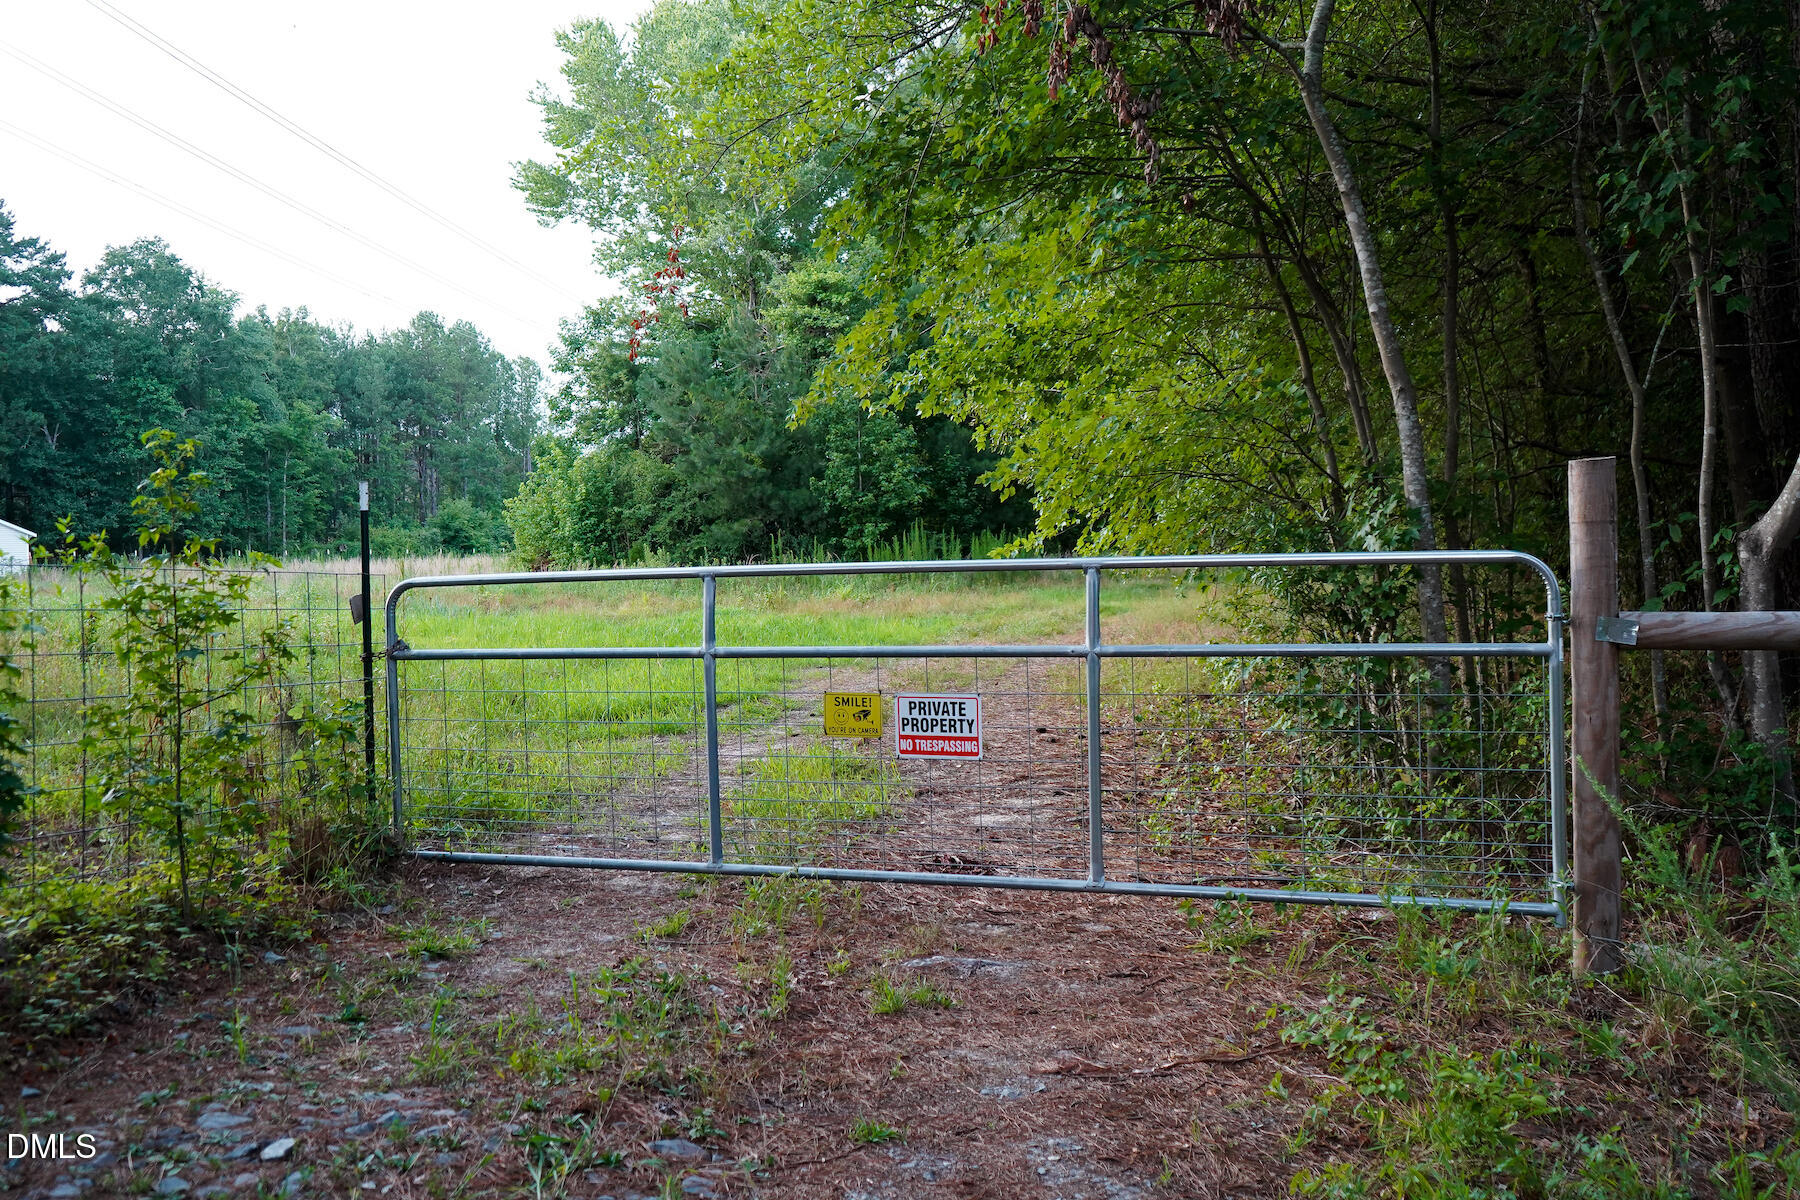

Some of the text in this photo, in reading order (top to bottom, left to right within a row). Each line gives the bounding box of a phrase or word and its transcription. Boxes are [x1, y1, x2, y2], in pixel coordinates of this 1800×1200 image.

[834, 696, 872, 707] SMILE!
[909, 701, 966, 716] PRIVATE
[858, 727, 879, 735] CAMERA
[901, 717, 975, 733] PROPERTY
[900, 738, 978, 753] NO TRESPASSING
